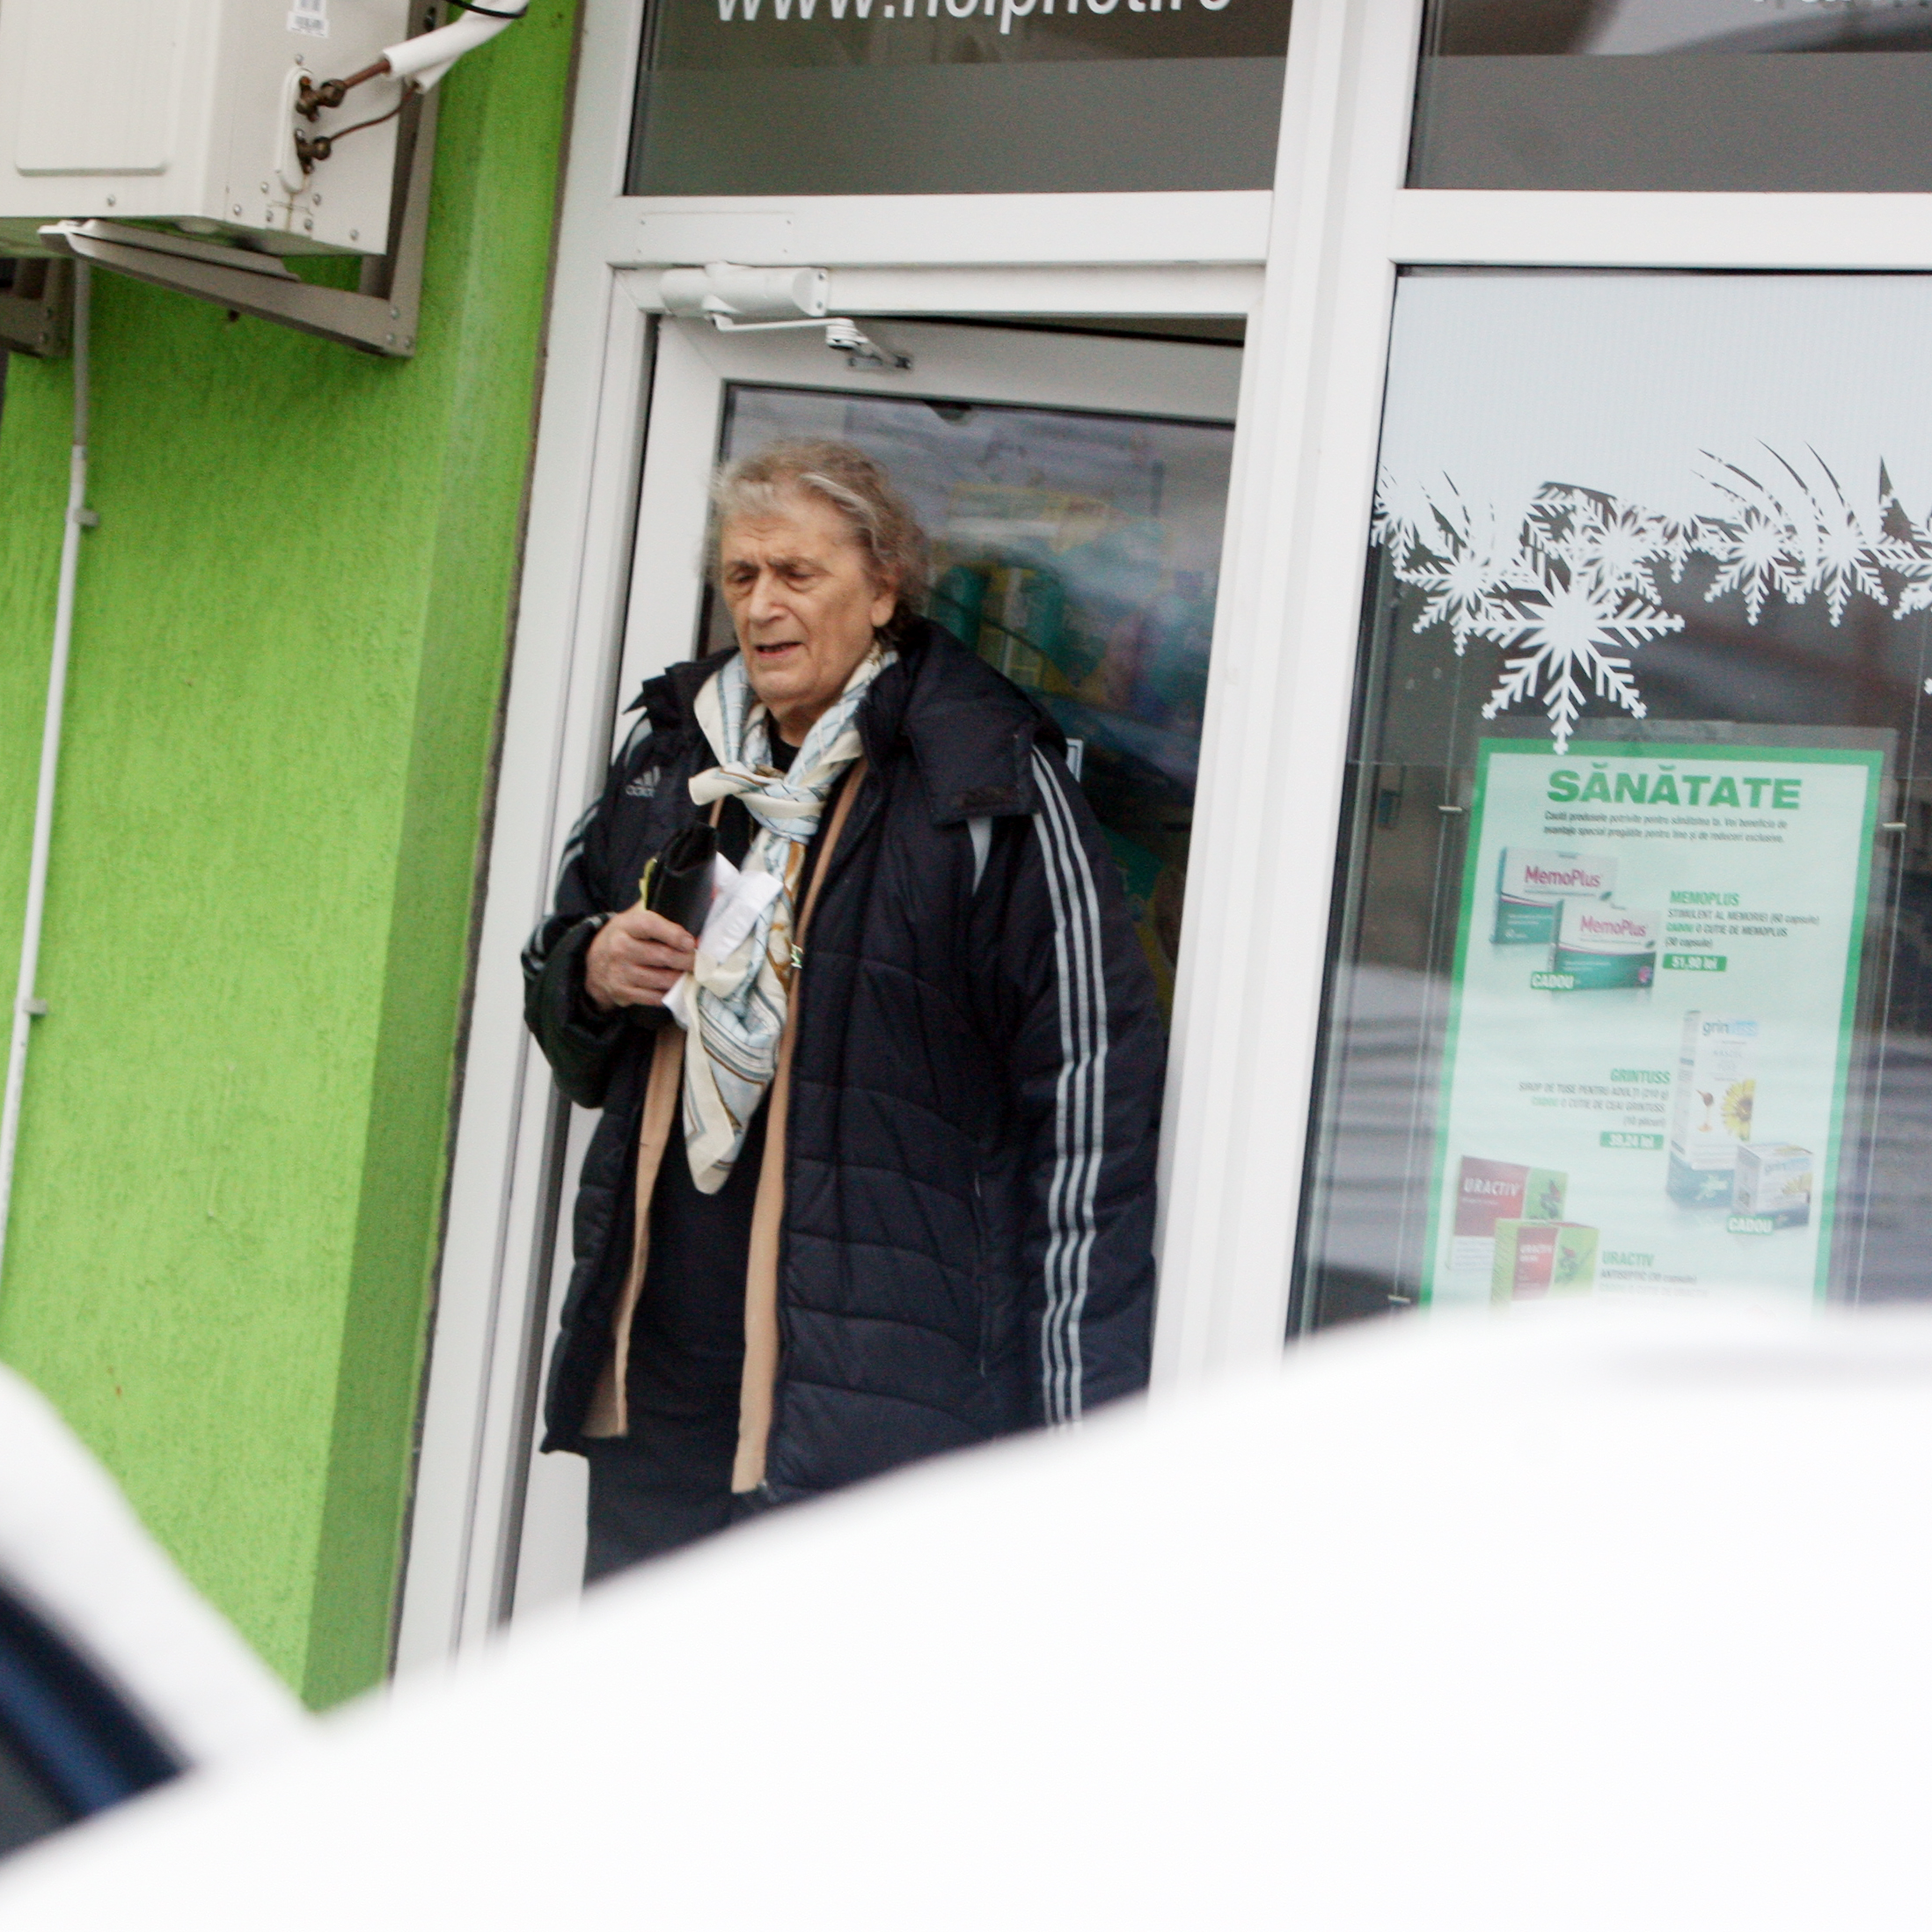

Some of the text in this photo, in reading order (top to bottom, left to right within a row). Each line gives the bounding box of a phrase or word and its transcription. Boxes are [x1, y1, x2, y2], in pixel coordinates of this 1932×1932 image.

[1547, 761, 1803, 810] SĂNĂTATE
[1525, 865, 1601, 888] MemoPlus
[1670, 890, 1740, 906] MEMOPLUS
[1580, 914, 1647, 937] MemoPlus
[1532, 973, 1575, 989] CADOU
[1610, 1067, 1671, 1085] GRINTUSS
[1463, 1176, 1521, 1197] URACTIV
[1728, 1217, 1774, 1233] CADOU
[1602, 1250, 1655, 1268] URACTIV
